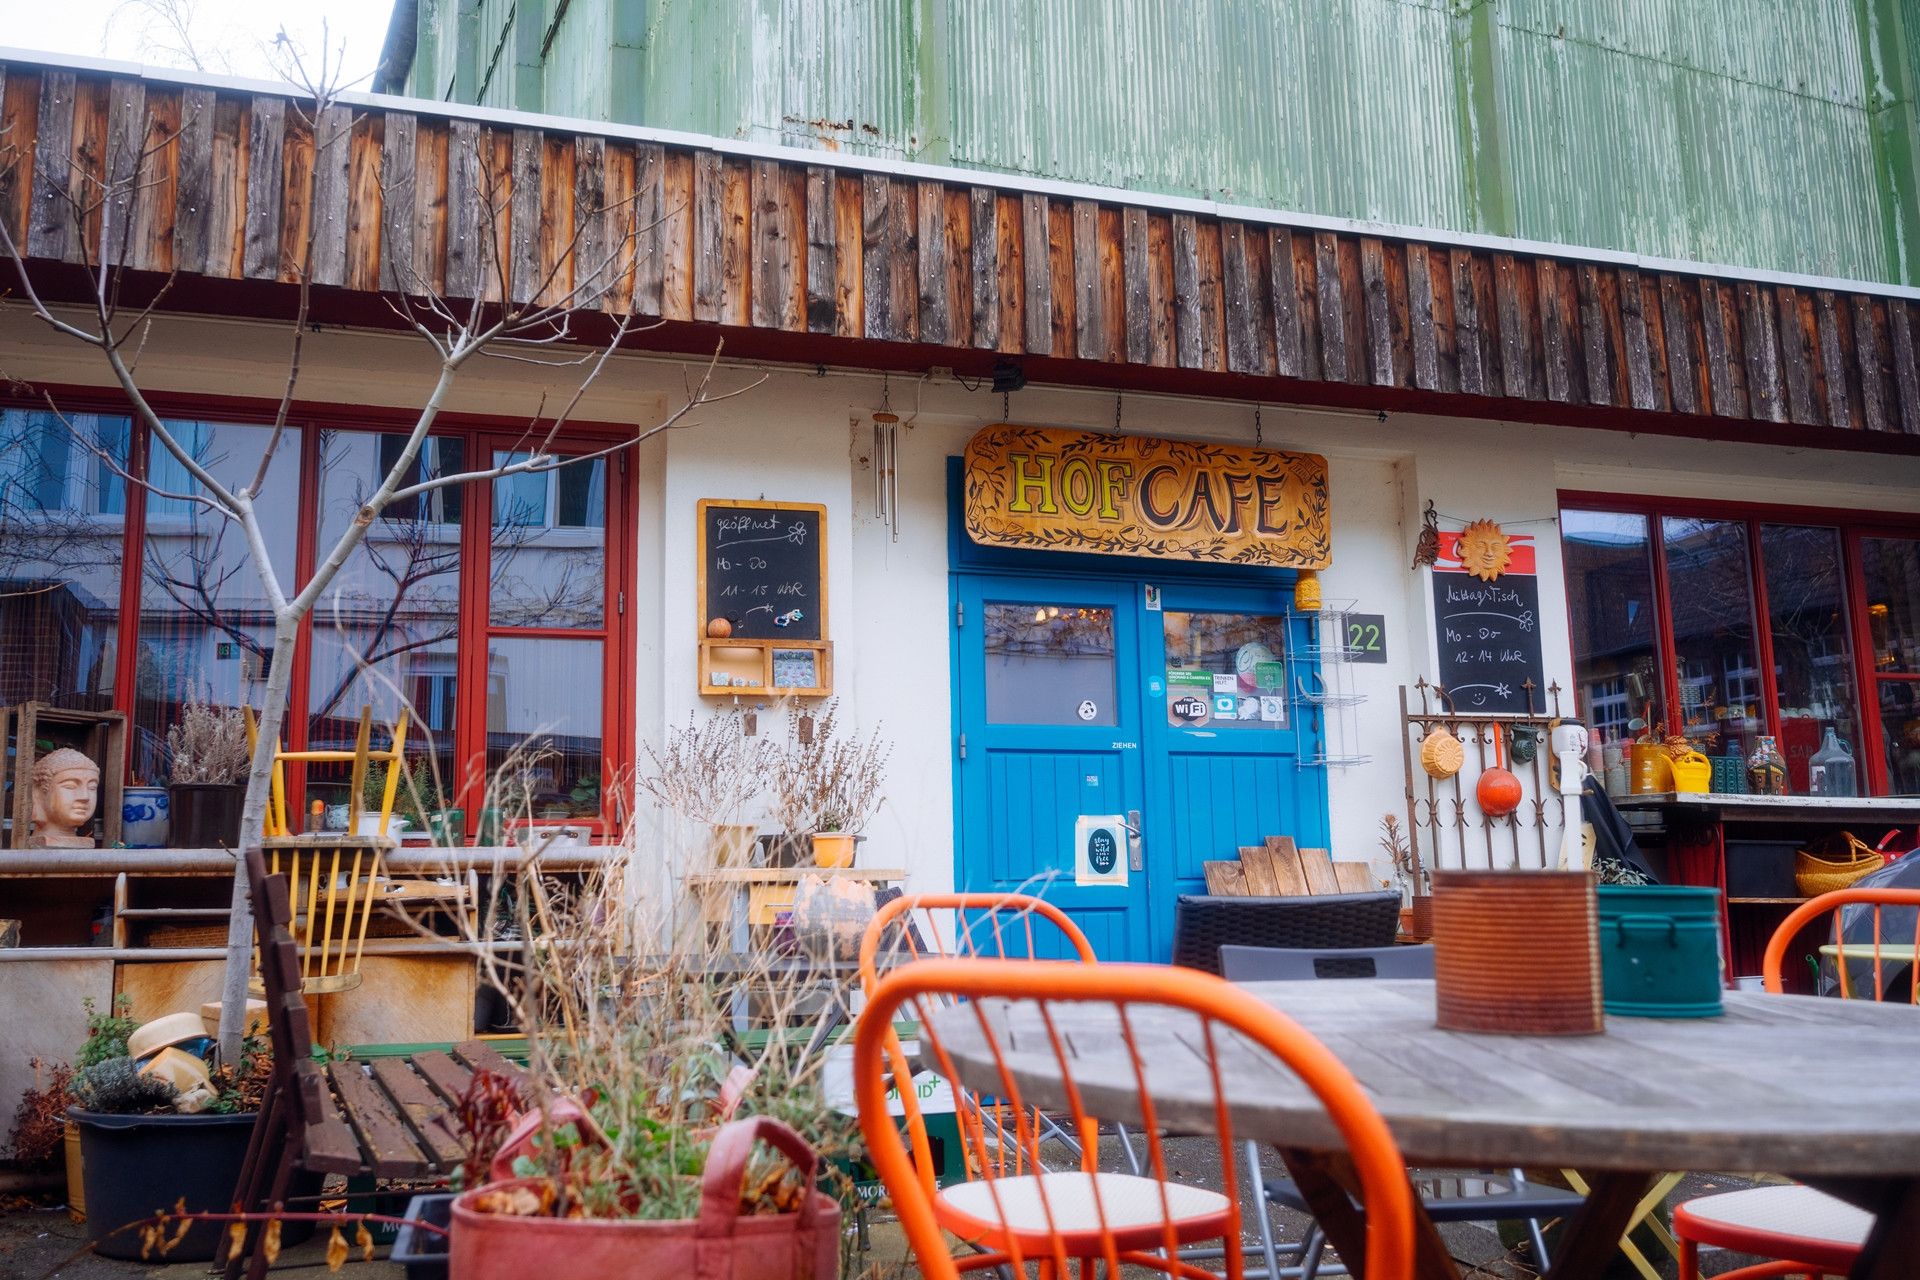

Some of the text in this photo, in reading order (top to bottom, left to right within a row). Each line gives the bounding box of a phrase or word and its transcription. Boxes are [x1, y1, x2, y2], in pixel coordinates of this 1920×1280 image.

[1007, 452, 1133, 521] HOF
[717, 514, 780, 540] geöffnet
[717, 557, 731, 570] Mo
[749, 557, 767, 570] Do
[1349, 623, 1381, 651] 22
[1446, 627, 1462, 644] Mo
[1478, 627, 1501, 640] Do
[1094, 837, 1110, 845] stay
[1095, 845, 1110, 853] wild
[1095, 855, 1110, 864] free
